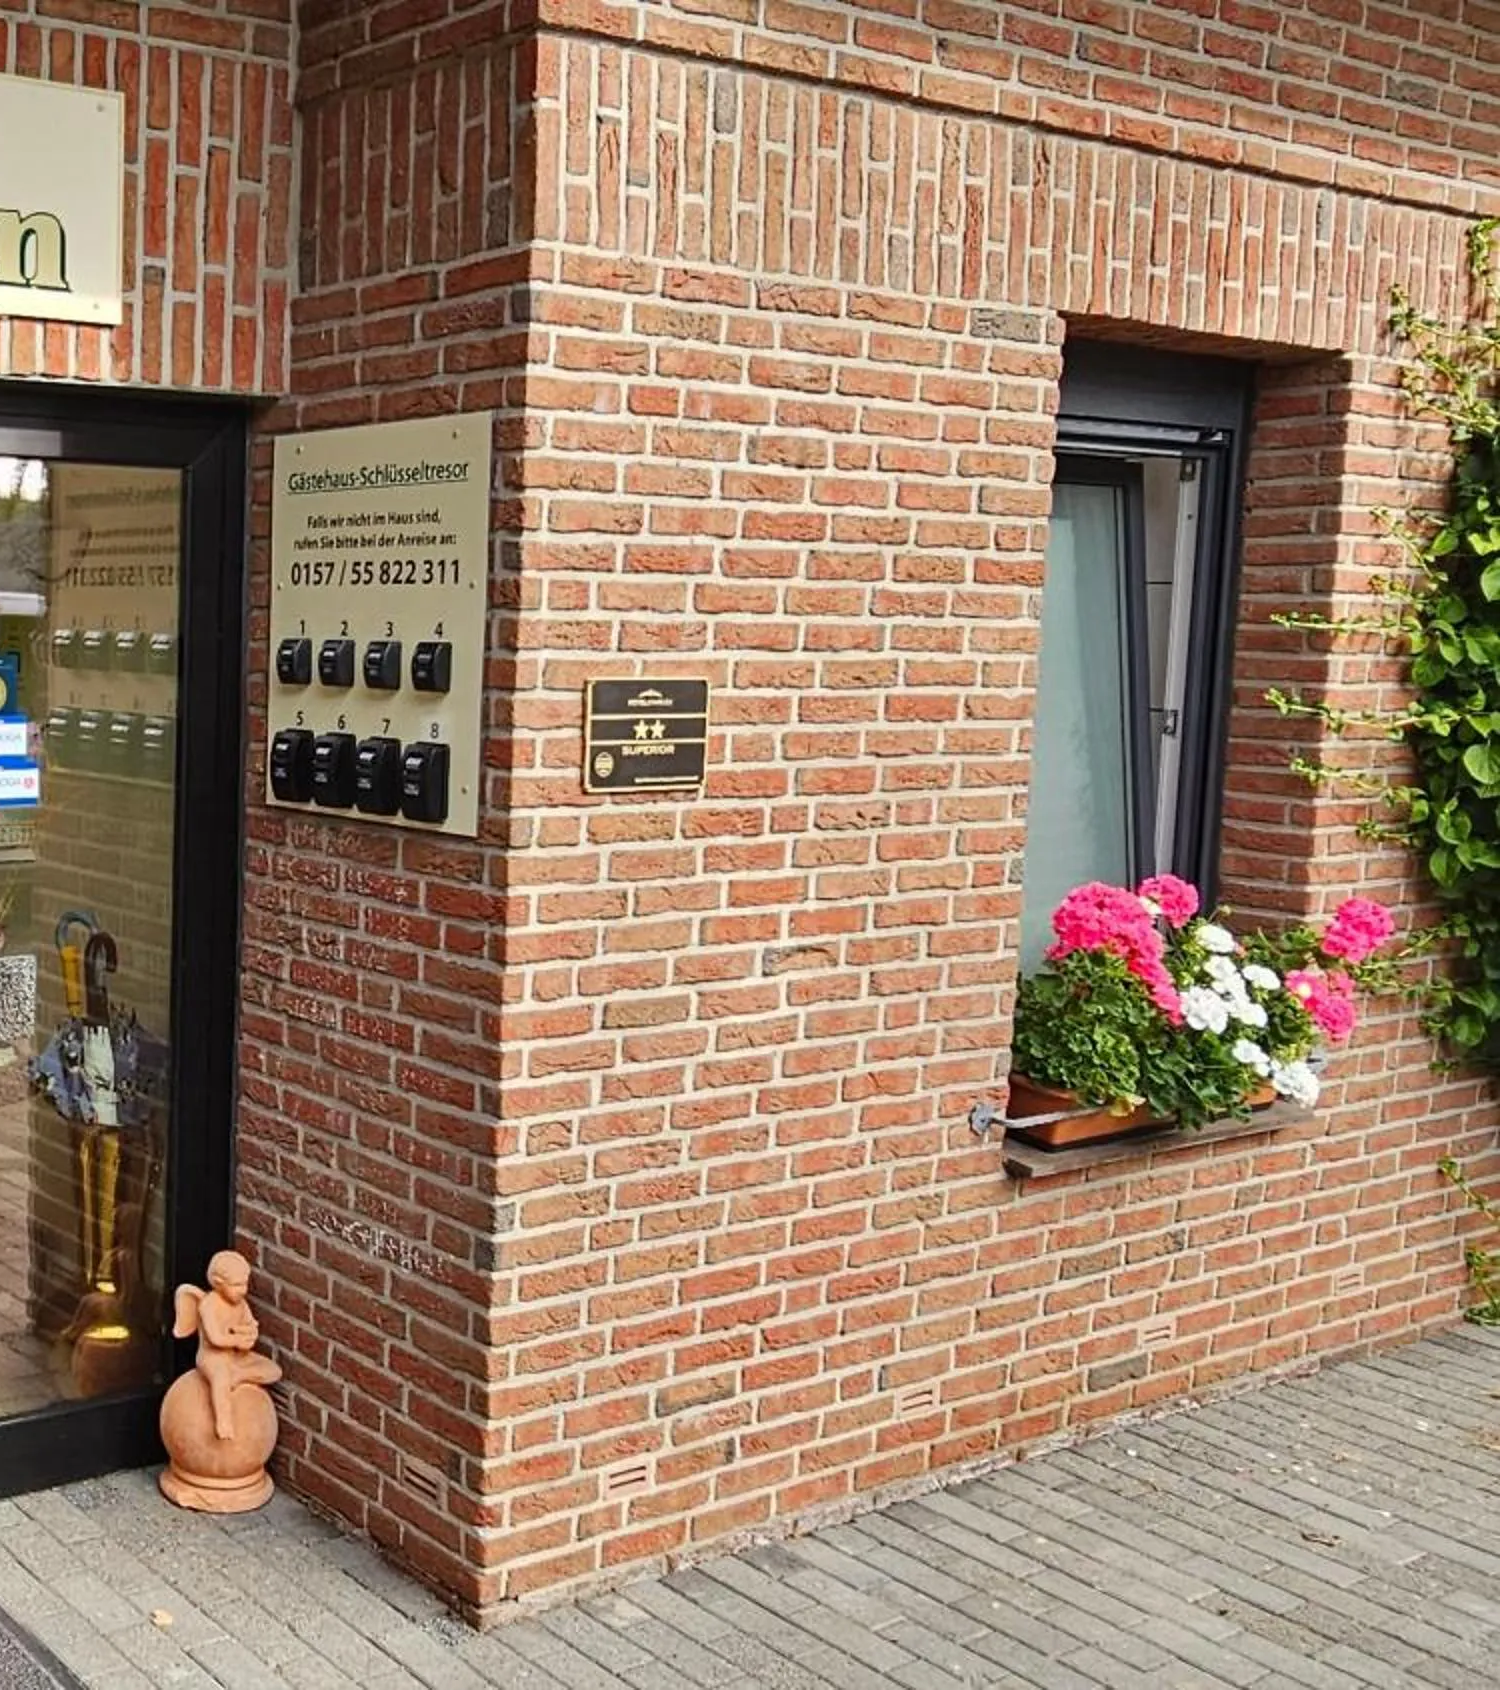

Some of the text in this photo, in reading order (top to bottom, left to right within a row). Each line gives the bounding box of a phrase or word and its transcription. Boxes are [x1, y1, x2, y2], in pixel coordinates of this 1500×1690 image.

[287, 460, 470, 491] Gästehaus-Schlüsseltresor
[307, 506, 441, 529] Falls wir nicht im Haus sind,
[293, 531, 457, 551] rufen Sie bitte bei der Anreise an:
[291, 559, 459, 587] 0157 / 55 822 311
[300, 619, 443, 639] 1 2 3 4
[296, 711, 440, 739] 5 6 7 8
[622, 743, 675, 757] SUPERIOR
